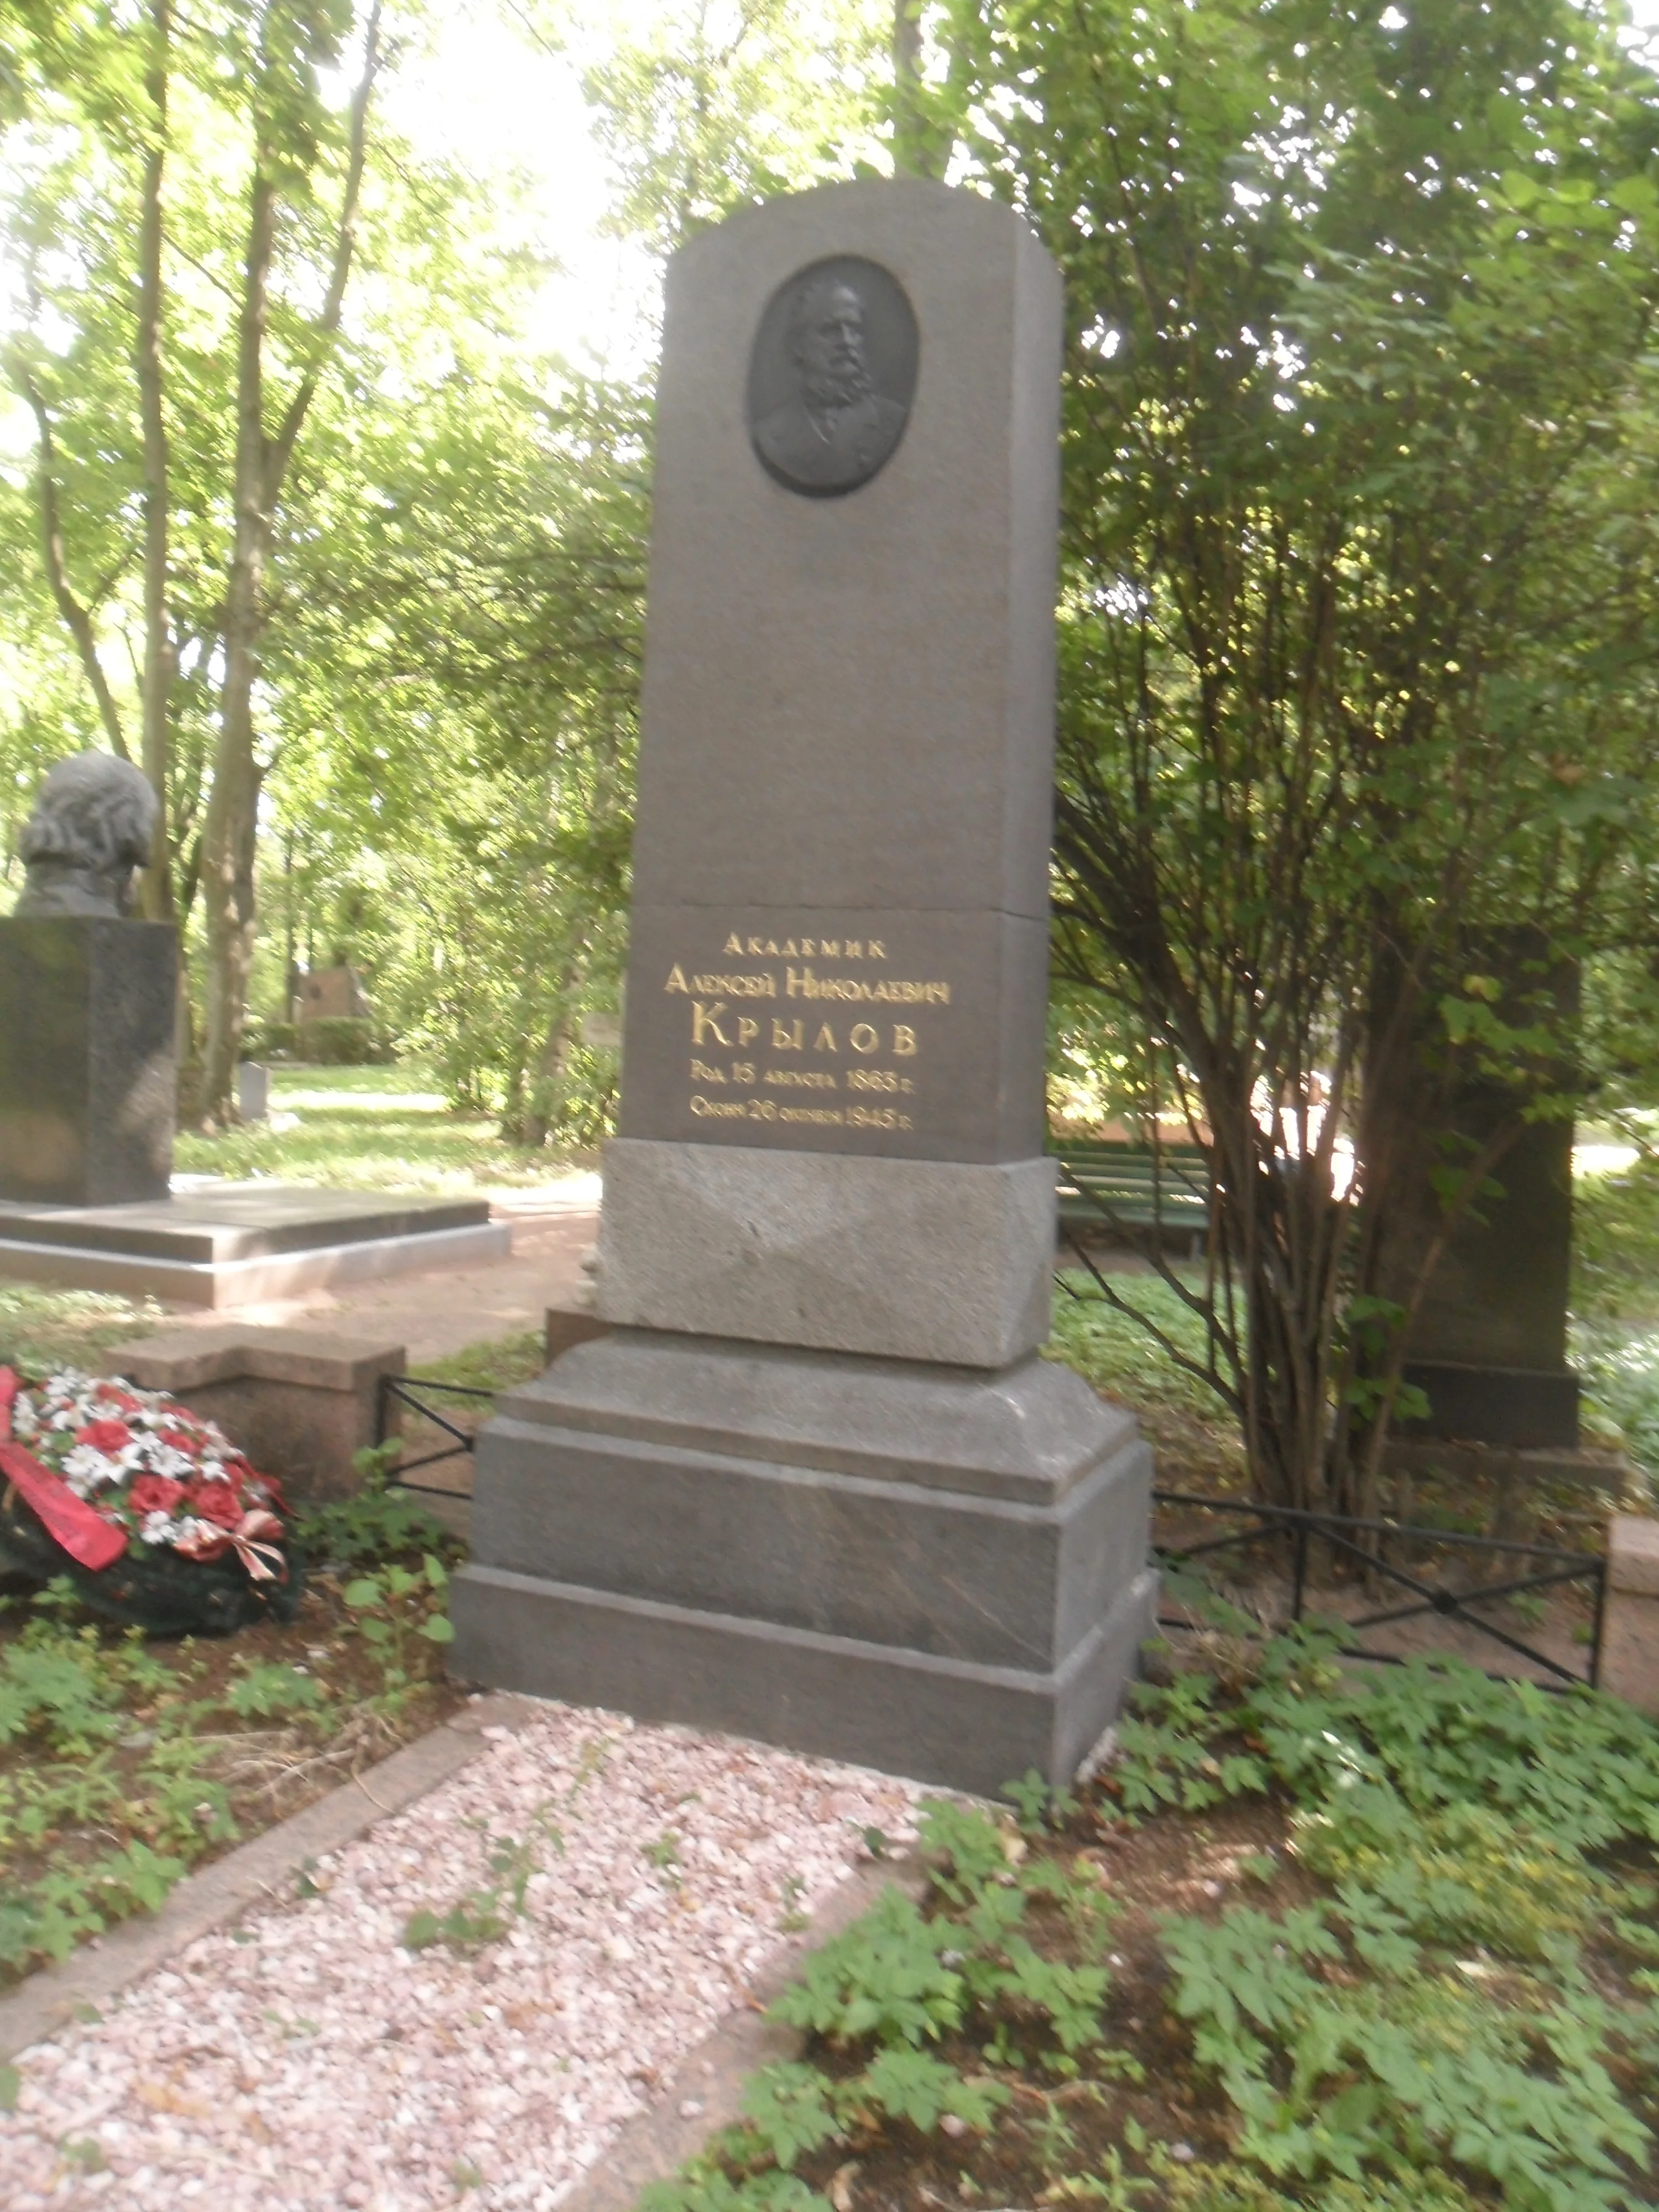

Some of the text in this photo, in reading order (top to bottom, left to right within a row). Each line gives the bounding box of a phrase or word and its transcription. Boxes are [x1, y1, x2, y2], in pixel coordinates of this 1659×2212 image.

[722, 931, 889, 959] АКАДЕМИК
[664, 963, 951, 1005] АЛЕКСЕЙ НИКОЛАЕВИЧ
[691, 1000, 918, 1057] КРЫЛОВ
[731, 1061, 757, 1084] 15
